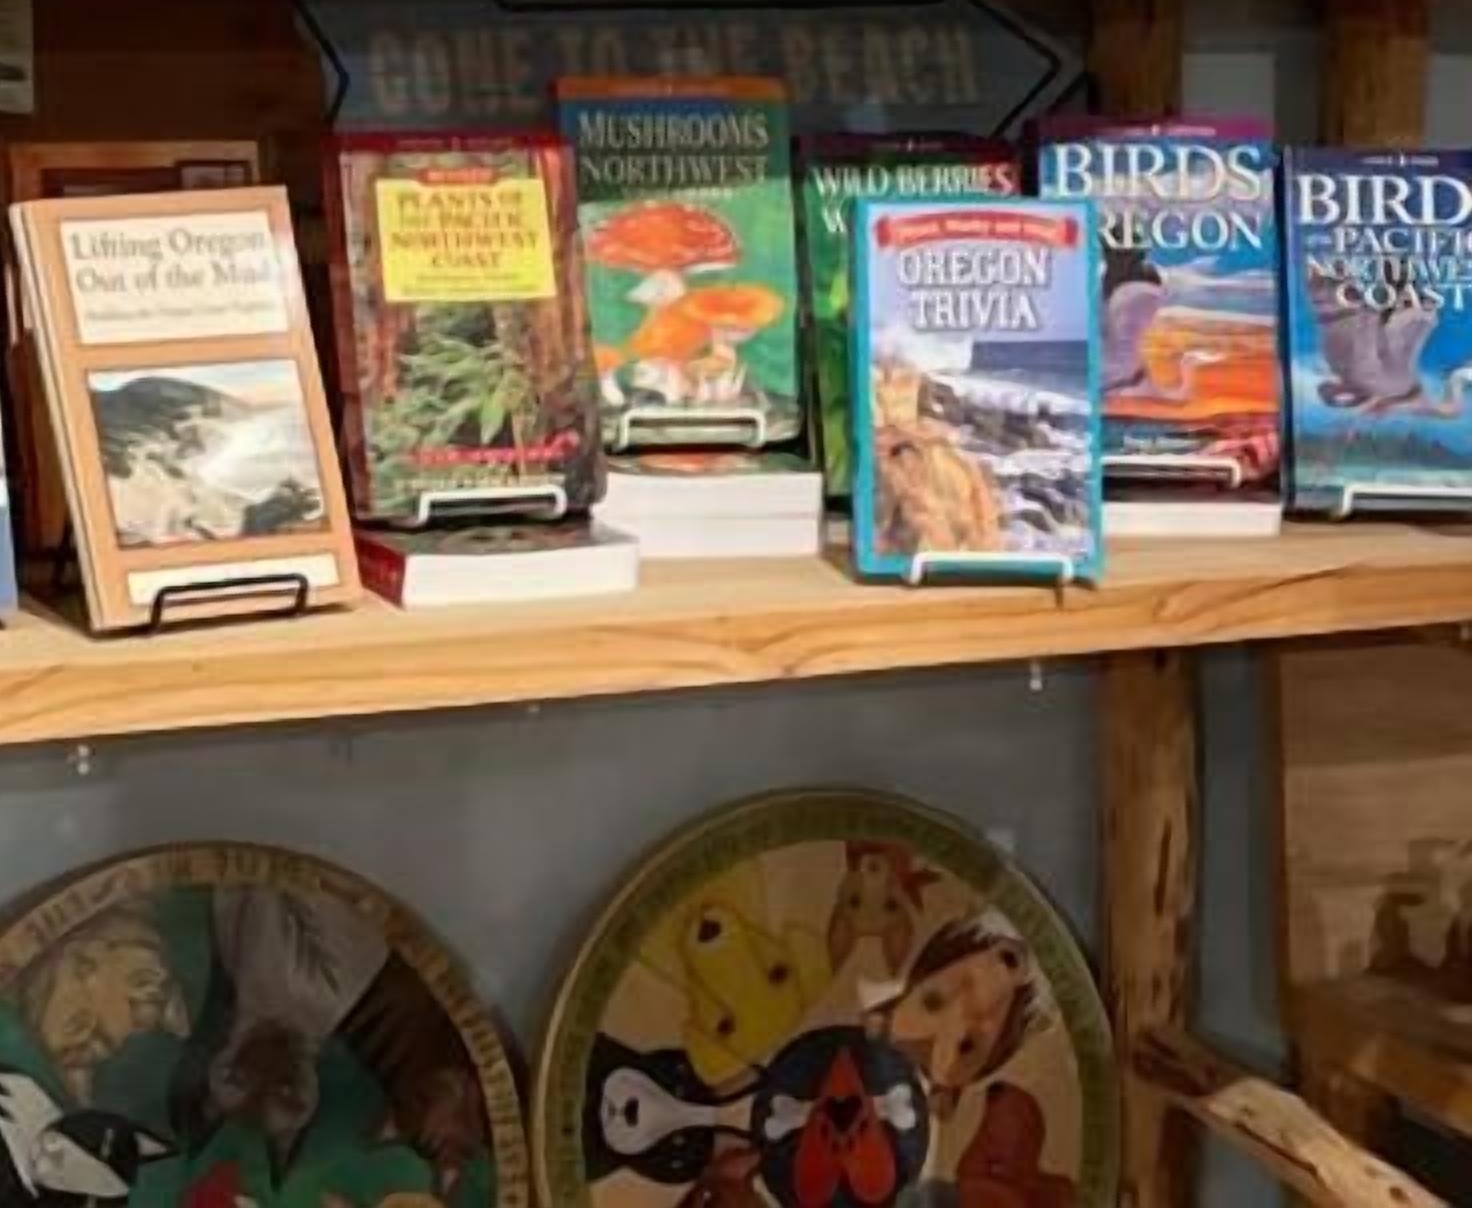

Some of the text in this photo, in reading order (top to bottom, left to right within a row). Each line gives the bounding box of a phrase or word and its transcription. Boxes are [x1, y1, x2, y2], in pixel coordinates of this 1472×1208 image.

[578, 110, 769, 149] MUSHROOMS
[581, 155, 769, 185] NORTHWEST
[813, 162, 1014, 197] WILD BERRIES
[1054, 140, 1262, 202] BIRDS
[1297, 173, 1472, 225] BIRD
[72, 225, 265, 262] Lifting Oregon
[1099, 206, 1262, 251] REGON
[1334, 228, 1472, 254] PACIFI
[75, 266, 125, 293] Out
[133, 262, 160, 291] of
[166, 265, 206, 288] the
[899, 249, 1054, 290] OREGON
[913, 291, 1038, 330] TRIVIA
[1336, 282, 1470, 312] COAST
